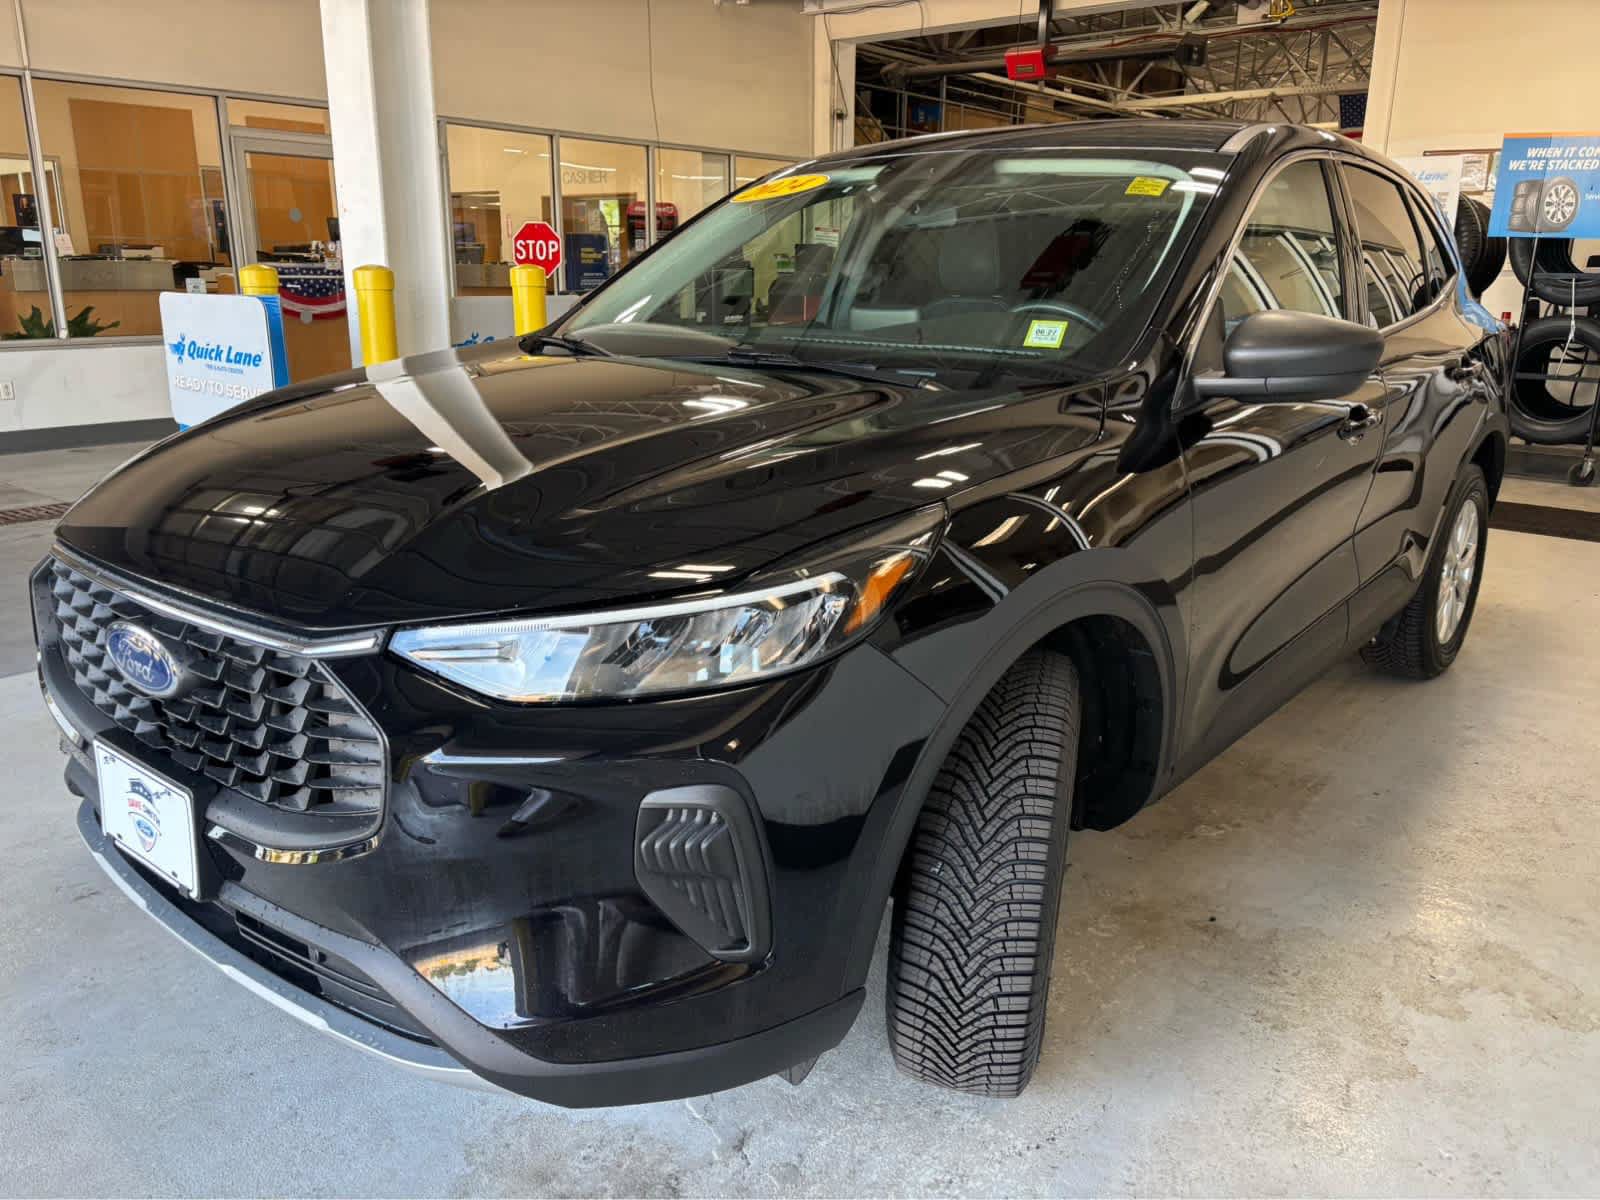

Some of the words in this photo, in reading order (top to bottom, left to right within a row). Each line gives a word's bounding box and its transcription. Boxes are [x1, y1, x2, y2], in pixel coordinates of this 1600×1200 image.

[1526, 147, 1563, 158] WHEN
[1563, 146, 1577, 158] IT
[1508, 159, 1545, 171] WE'RE
[1547, 159, 1599, 171] STACKED
[516, 239, 559, 261] STOP
[187, 340, 224, 361] Quick
[225, 345, 262, 368] Lane
[174, 376, 207, 393] READY
[207, 379, 224, 396] TO
[116, 637, 155, 683] Ford
